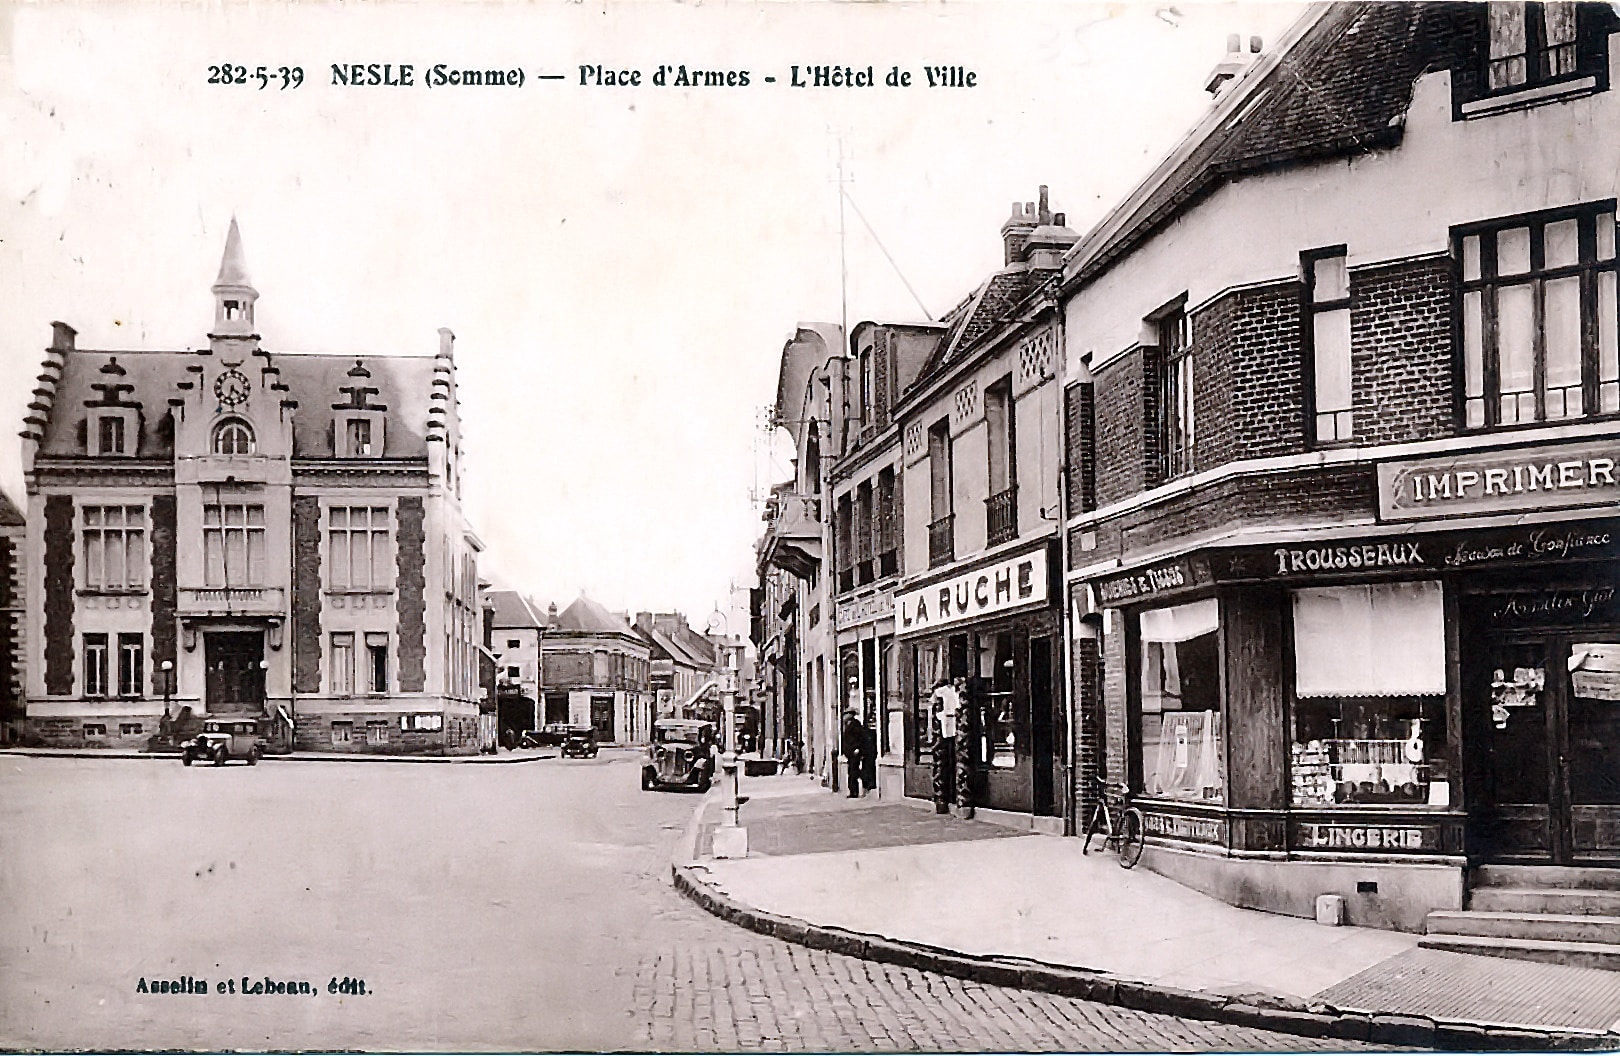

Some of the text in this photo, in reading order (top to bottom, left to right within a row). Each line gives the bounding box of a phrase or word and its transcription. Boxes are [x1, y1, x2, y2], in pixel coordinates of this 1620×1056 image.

[1274, 542, 1424, 576] TROUSSEAUX
[902, 595, 929, 628] LA
[939, 560, 1033, 620] RUCHE
[1307, 824, 1422, 848] LINGERIE
